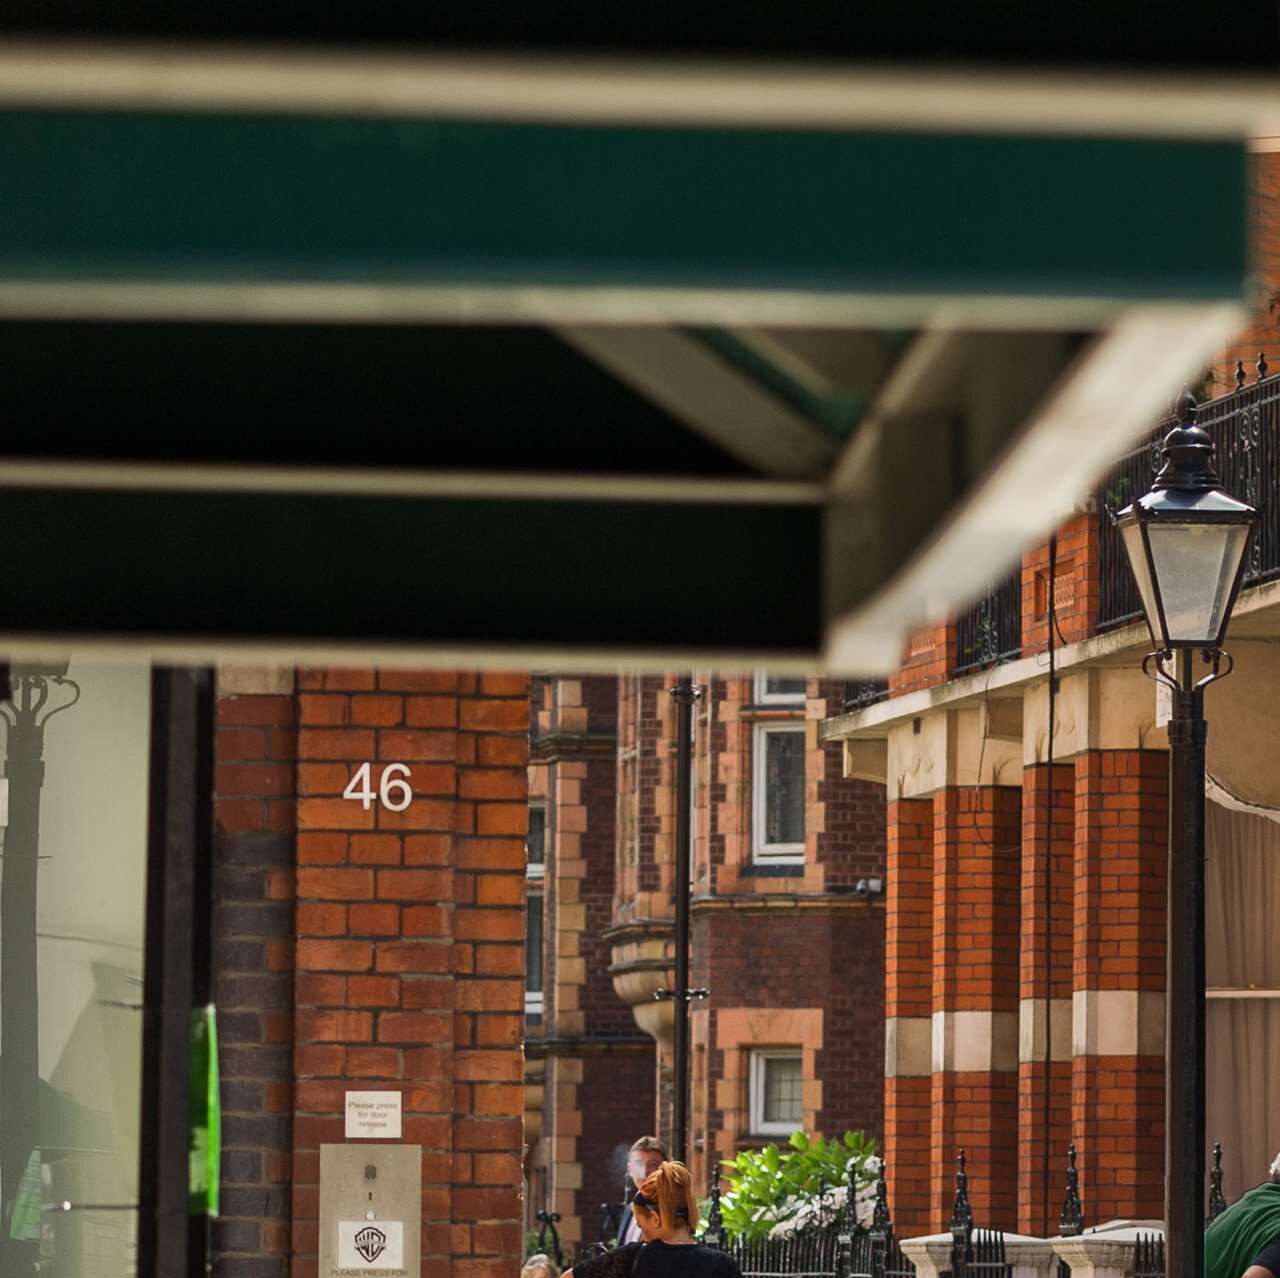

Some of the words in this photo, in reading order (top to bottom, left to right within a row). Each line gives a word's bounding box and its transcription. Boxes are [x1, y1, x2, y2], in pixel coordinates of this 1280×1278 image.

[343, 762, 412, 811] 46
[348, 1101, 375, 1109] Please
[330, 1269, 361, 1277] PLEASE
[363, 1269, 390, 1277] PRESS
[391, 1269, 408, 1277] FOR
